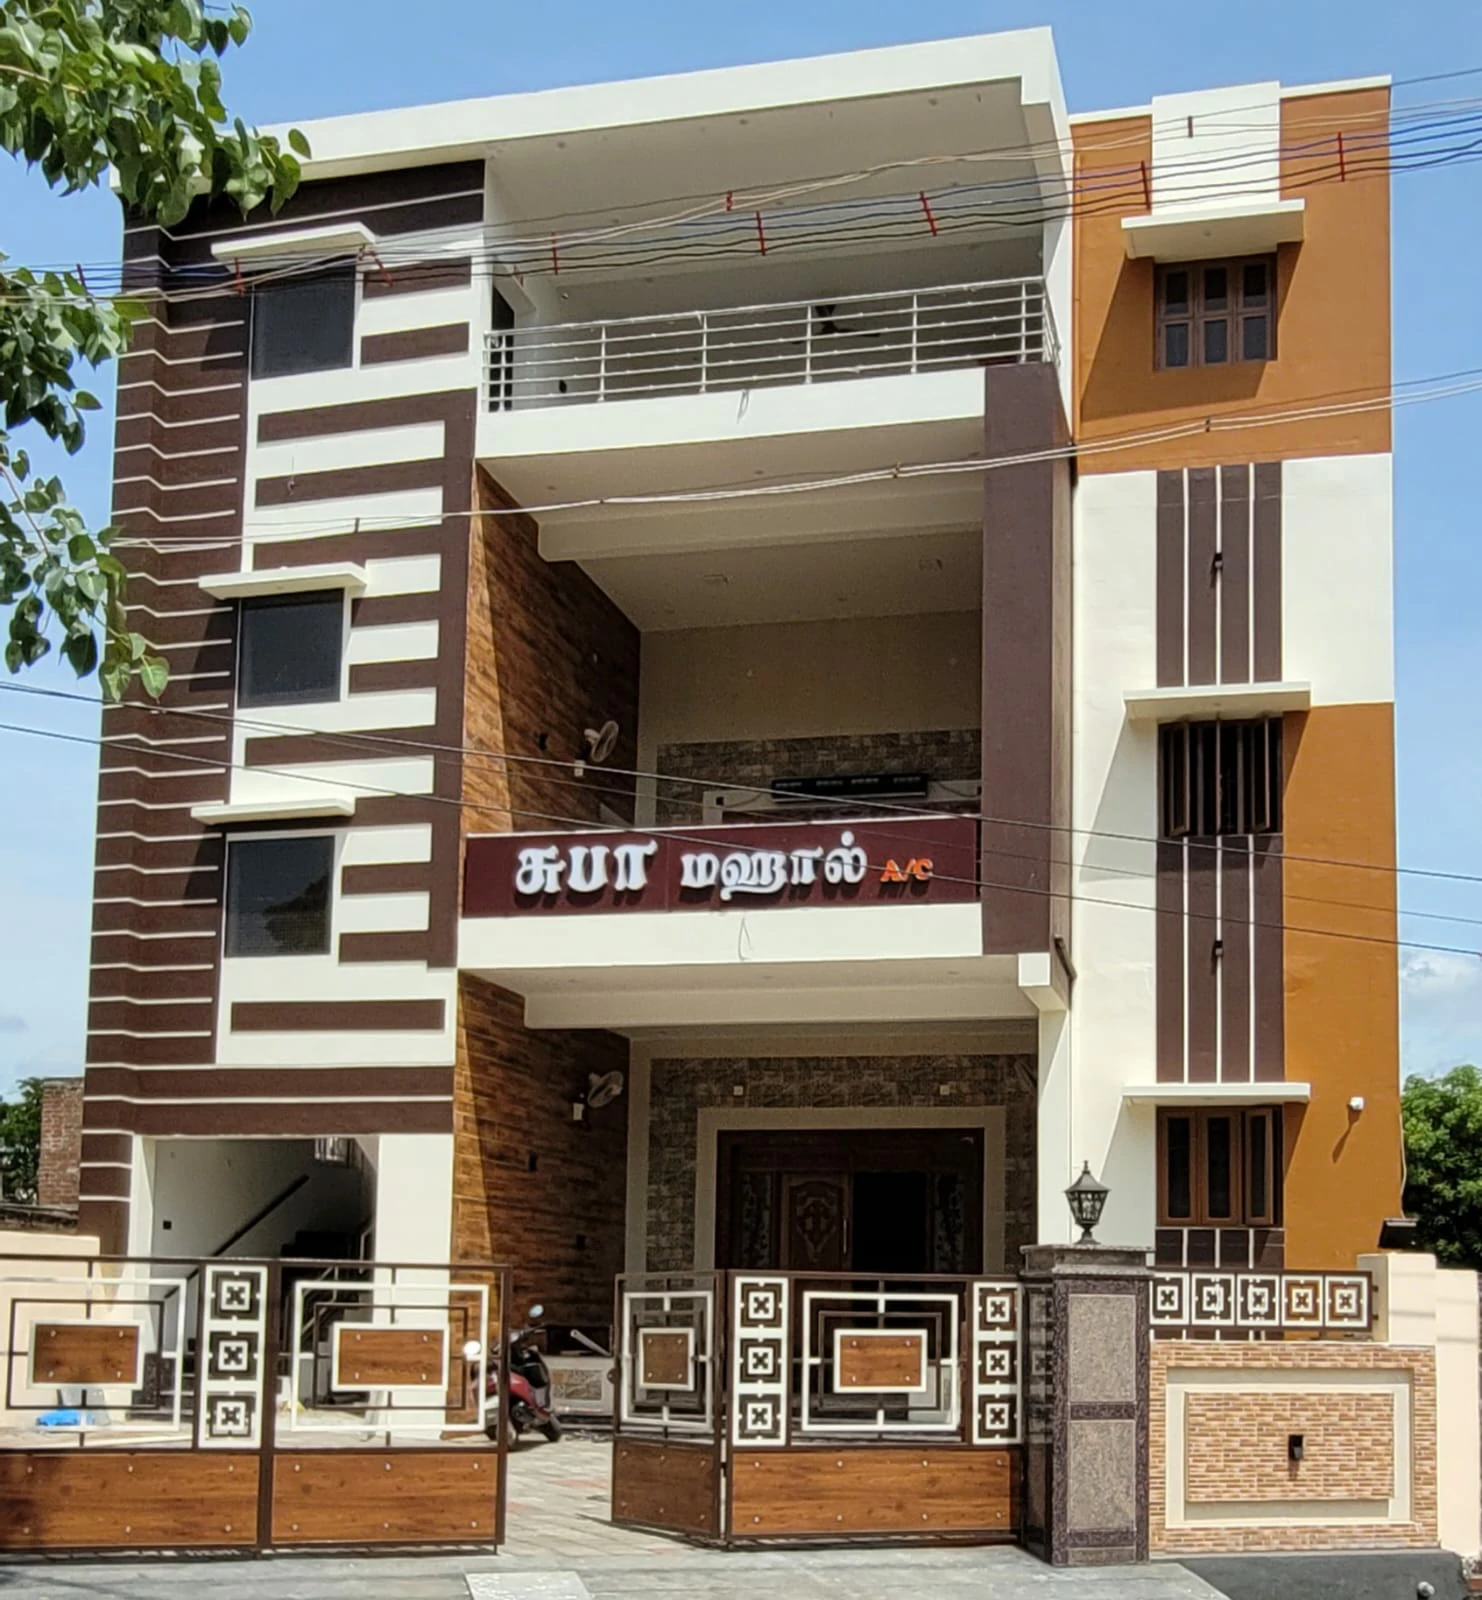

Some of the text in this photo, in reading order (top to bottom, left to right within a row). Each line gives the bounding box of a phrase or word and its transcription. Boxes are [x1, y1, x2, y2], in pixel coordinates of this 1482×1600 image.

[515, 830, 934, 901] சுபா மஹால் A/C
